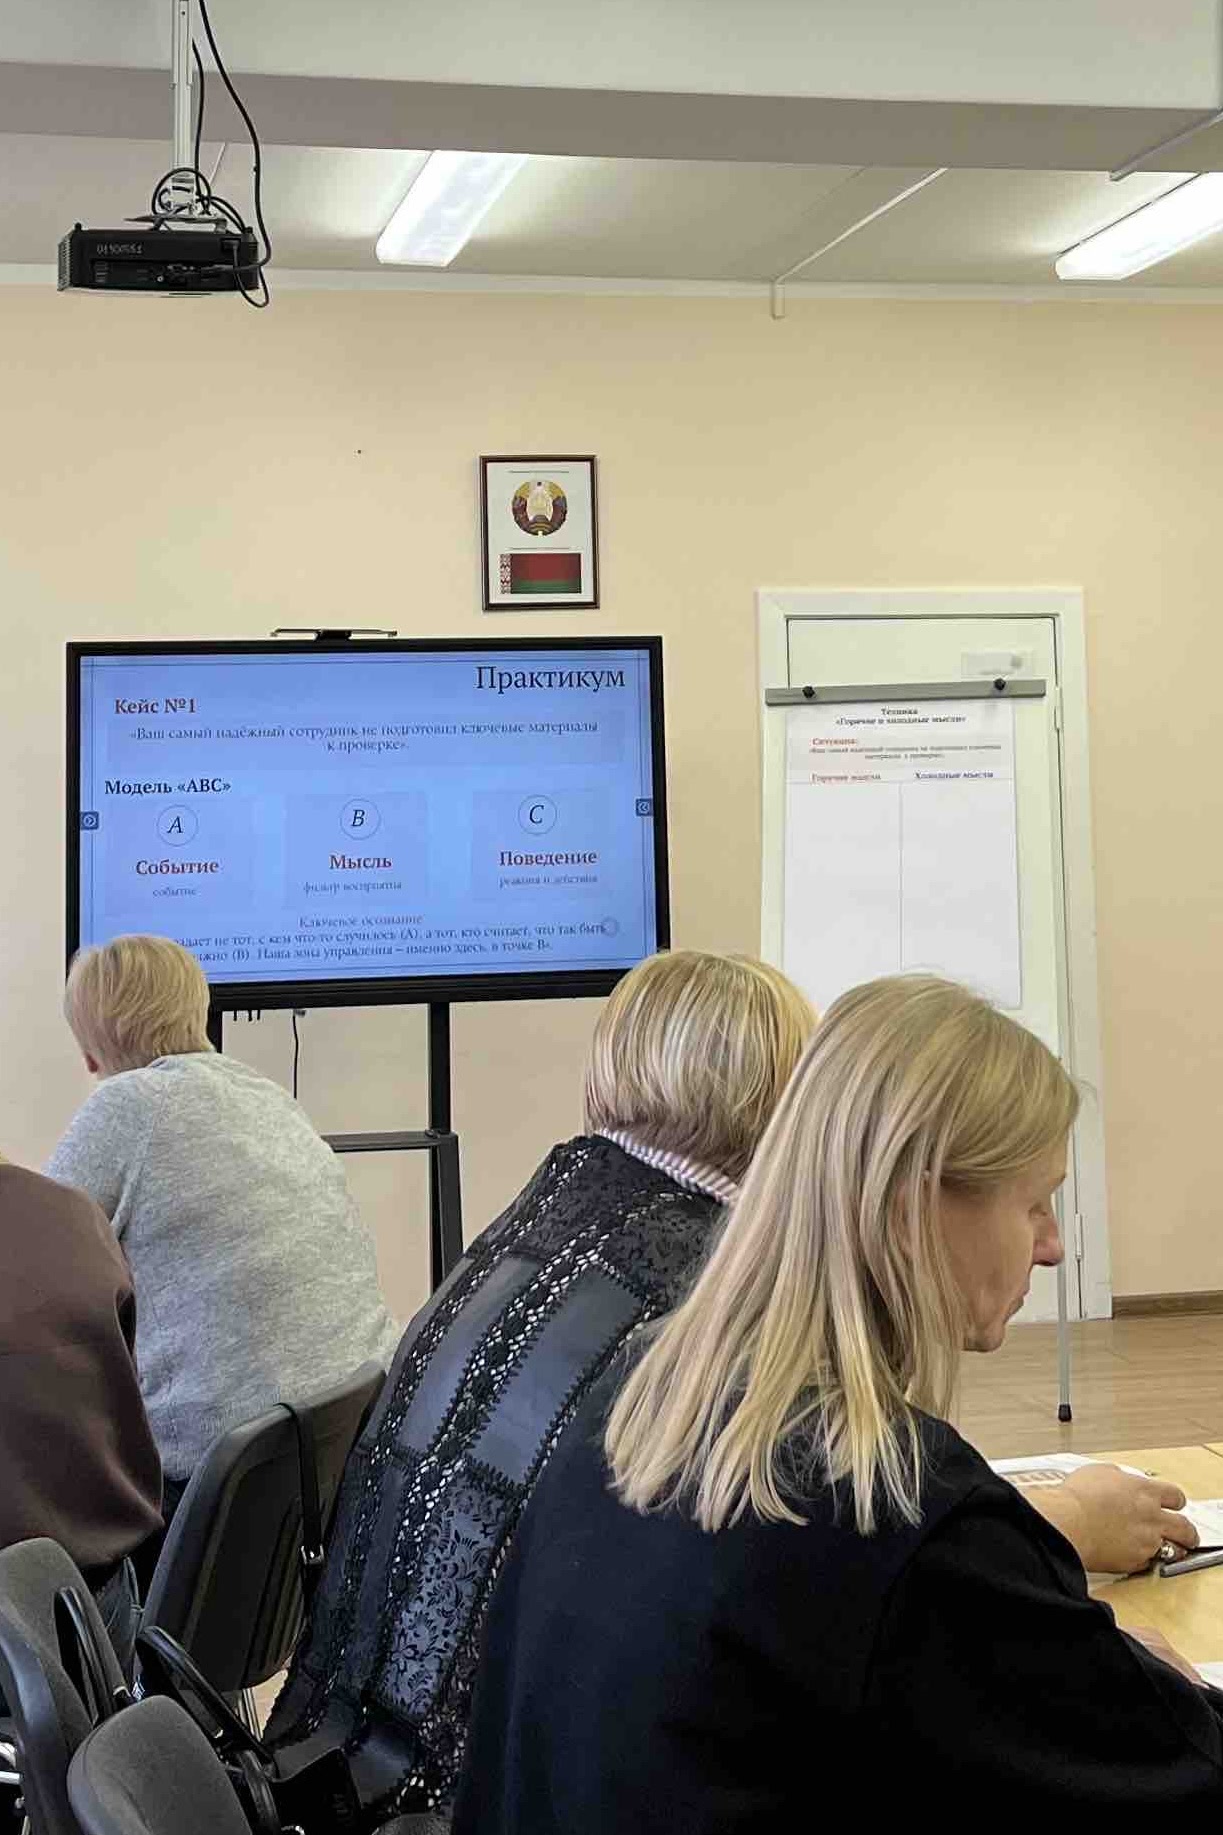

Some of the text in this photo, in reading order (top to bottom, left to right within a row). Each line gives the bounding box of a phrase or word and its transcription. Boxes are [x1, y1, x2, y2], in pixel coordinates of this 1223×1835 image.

[475, 666, 625, 694] Практикум
[114, 698, 197, 714] Кейс №1
[130, 727, 165, 740] «Ваш
[168, 725, 212, 739] самый
[289, 727, 357, 740] сотрудник
[361, 727, 377, 736] не
[382, 725, 456, 737] подготовил
[461, 723, 523, 736] ключевые
[529, 722, 598, 734] материалы
[327, 741, 335, 751] к
[104, 780, 172, 796] Модель
[136, 859, 219, 875] Событие
[329, 855, 393, 870] Мысль
[499, 851, 598, 867] Поведение
[215, 936, 229, 946] не
